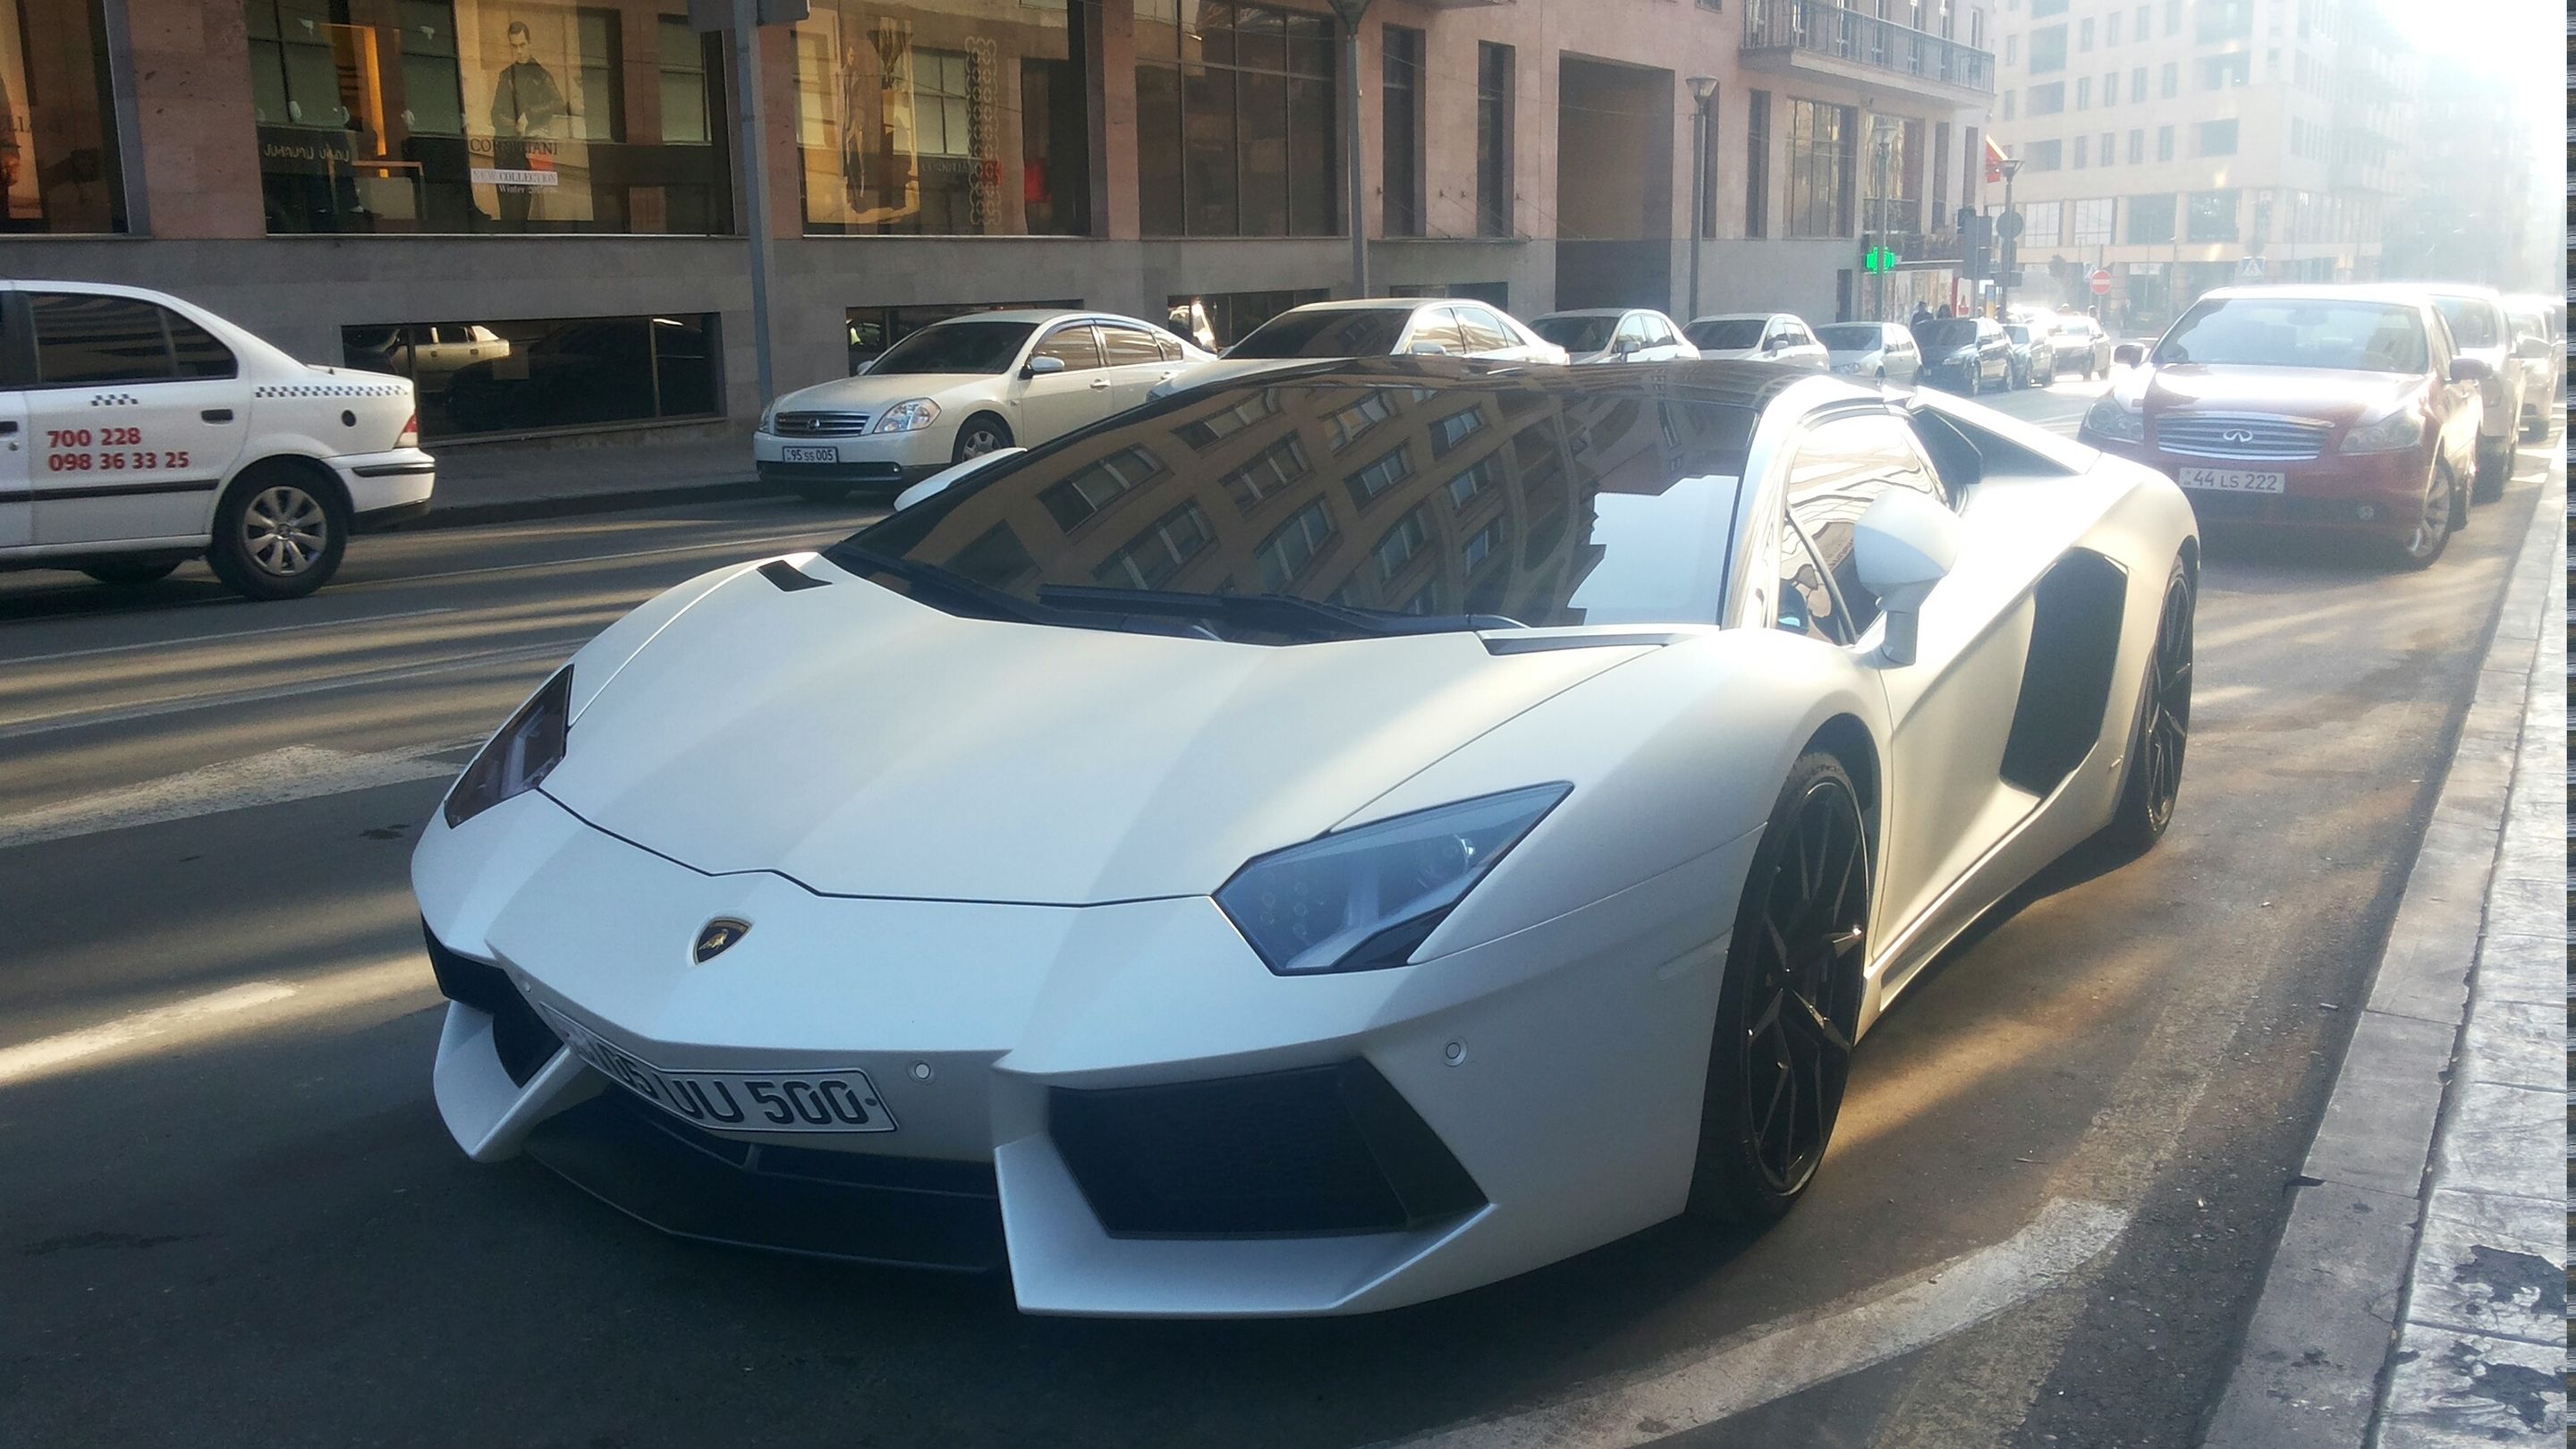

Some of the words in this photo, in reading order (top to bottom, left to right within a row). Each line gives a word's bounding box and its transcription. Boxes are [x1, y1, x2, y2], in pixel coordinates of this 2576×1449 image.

[47, 429, 92, 448] 700
[100, 428, 141, 445] 228
[48, 453, 92, 471] 098
[99, 452, 125, 470] 36
[132, 452, 157, 470] 33
[165, 451, 190, 468] 25
[791, 449, 802, 461] 95
[804, 452, 815, 461] SS
[816, 449, 834, 461] 005
[2193, 470, 2215, 487] 44
[2220, 475, 2239, 488] LS
[2244, 473, 2277, 491] 222
[745, 1080, 869, 1124] 500
